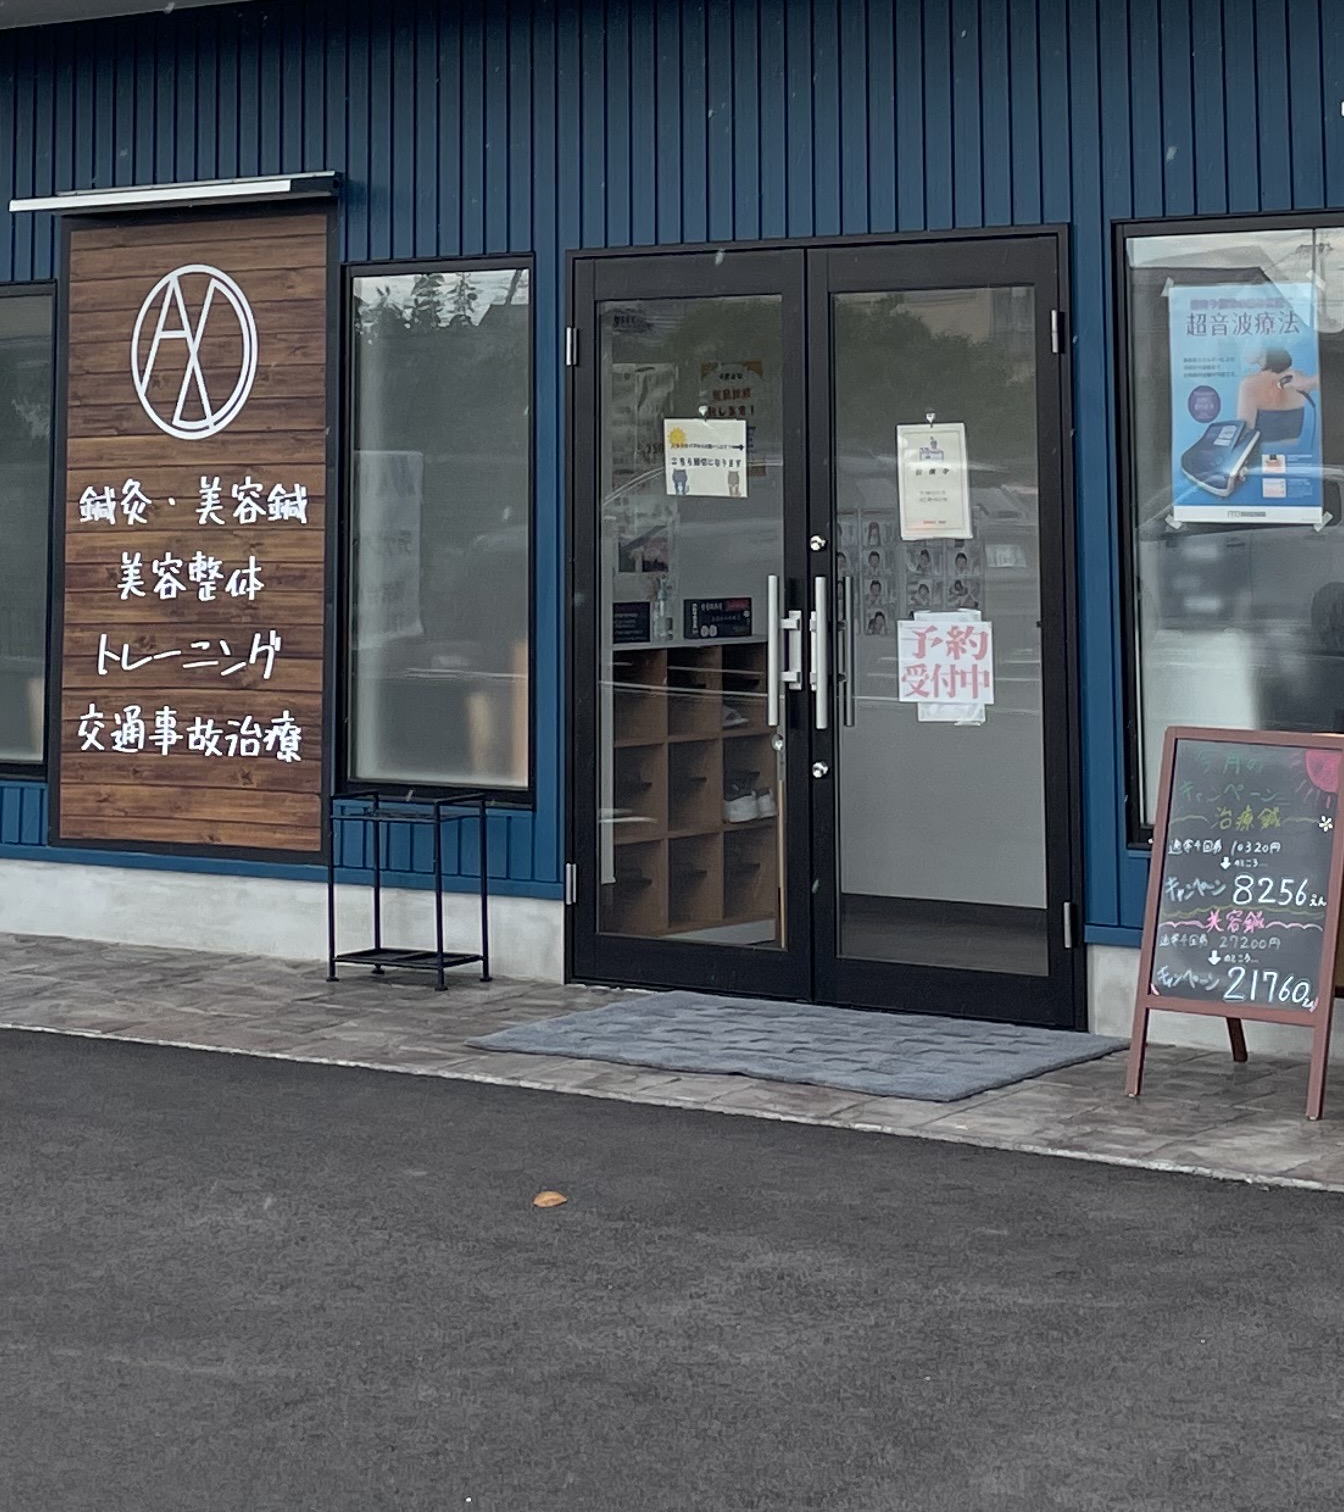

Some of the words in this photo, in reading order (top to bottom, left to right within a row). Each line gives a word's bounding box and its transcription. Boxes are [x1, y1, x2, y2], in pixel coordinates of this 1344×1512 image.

[1186, 310, 1301, 337] 超音波療法
[116, 550, 265, 603] 美容整体
[96, 629, 283, 679] トレーニング
[911, 625, 989, 660] 予約
[901, 663, 990, 699] 受付中
[77, 702, 304, 763] 交通事故治療
